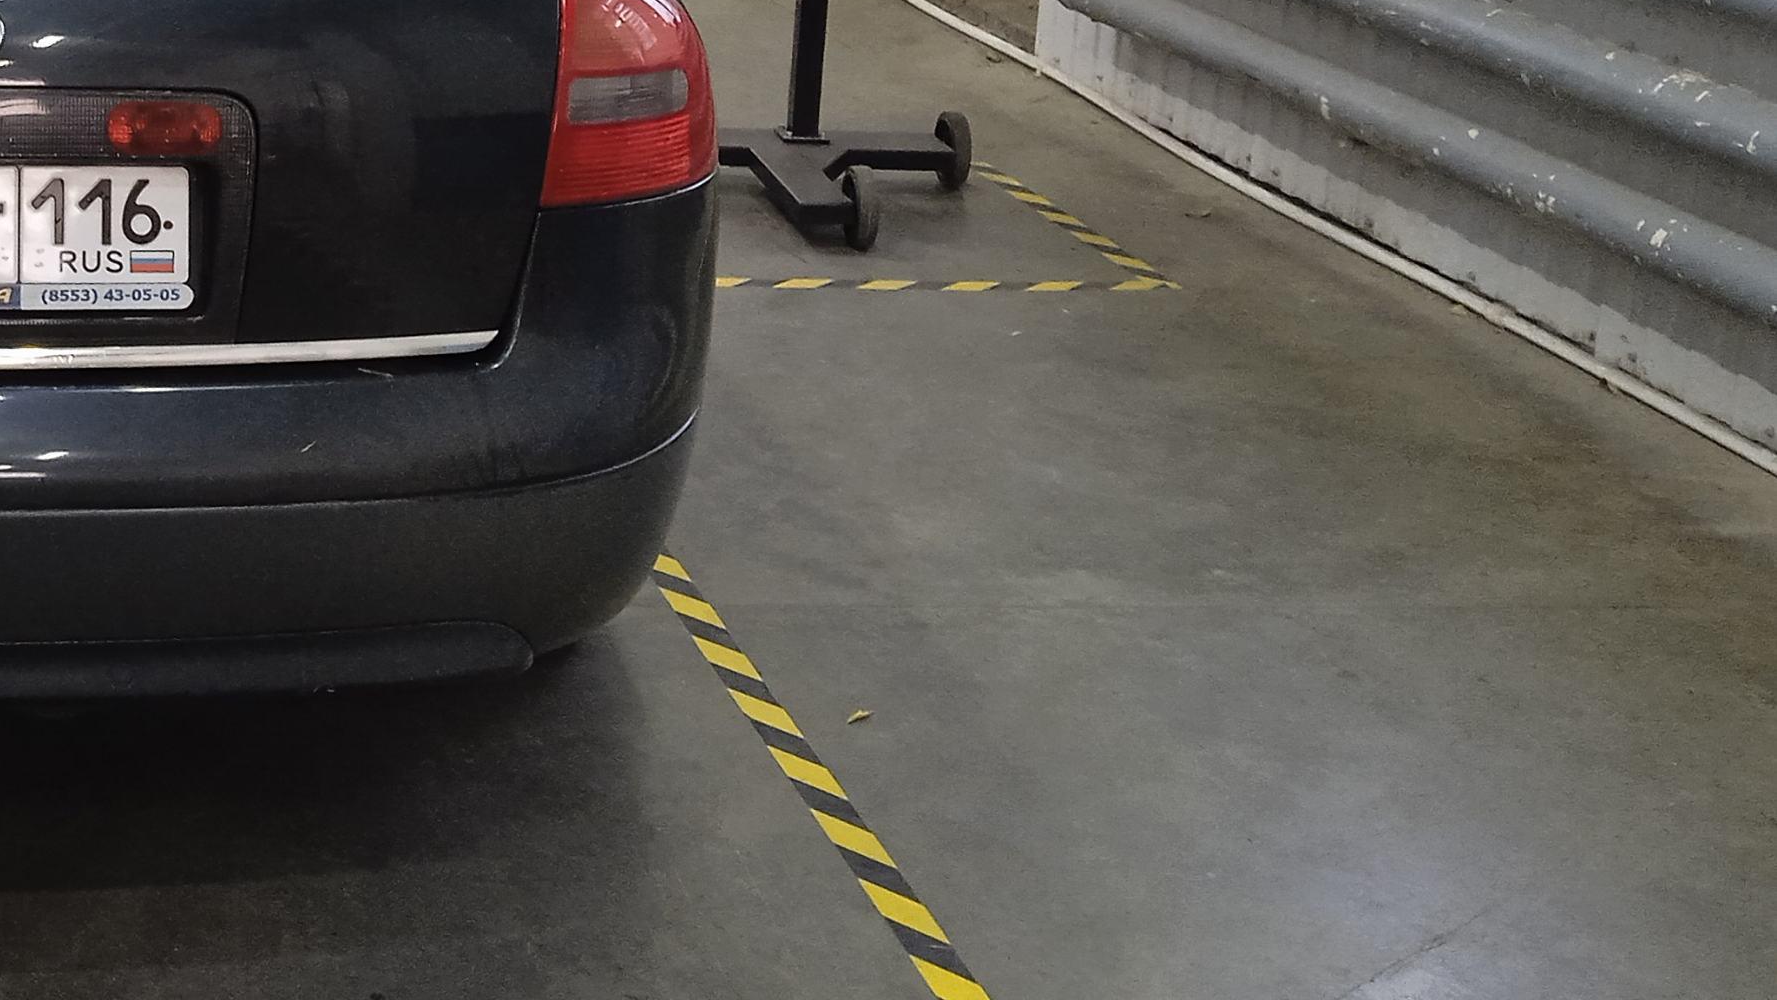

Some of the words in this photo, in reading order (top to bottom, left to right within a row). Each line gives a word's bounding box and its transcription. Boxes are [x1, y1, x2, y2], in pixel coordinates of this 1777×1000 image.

[30, 178, 162, 246] 116
[59, 251, 123, 273] RUS
[40, 289, 98, 305] (8553)
[103, 288, 181, 302] 43-05-05
